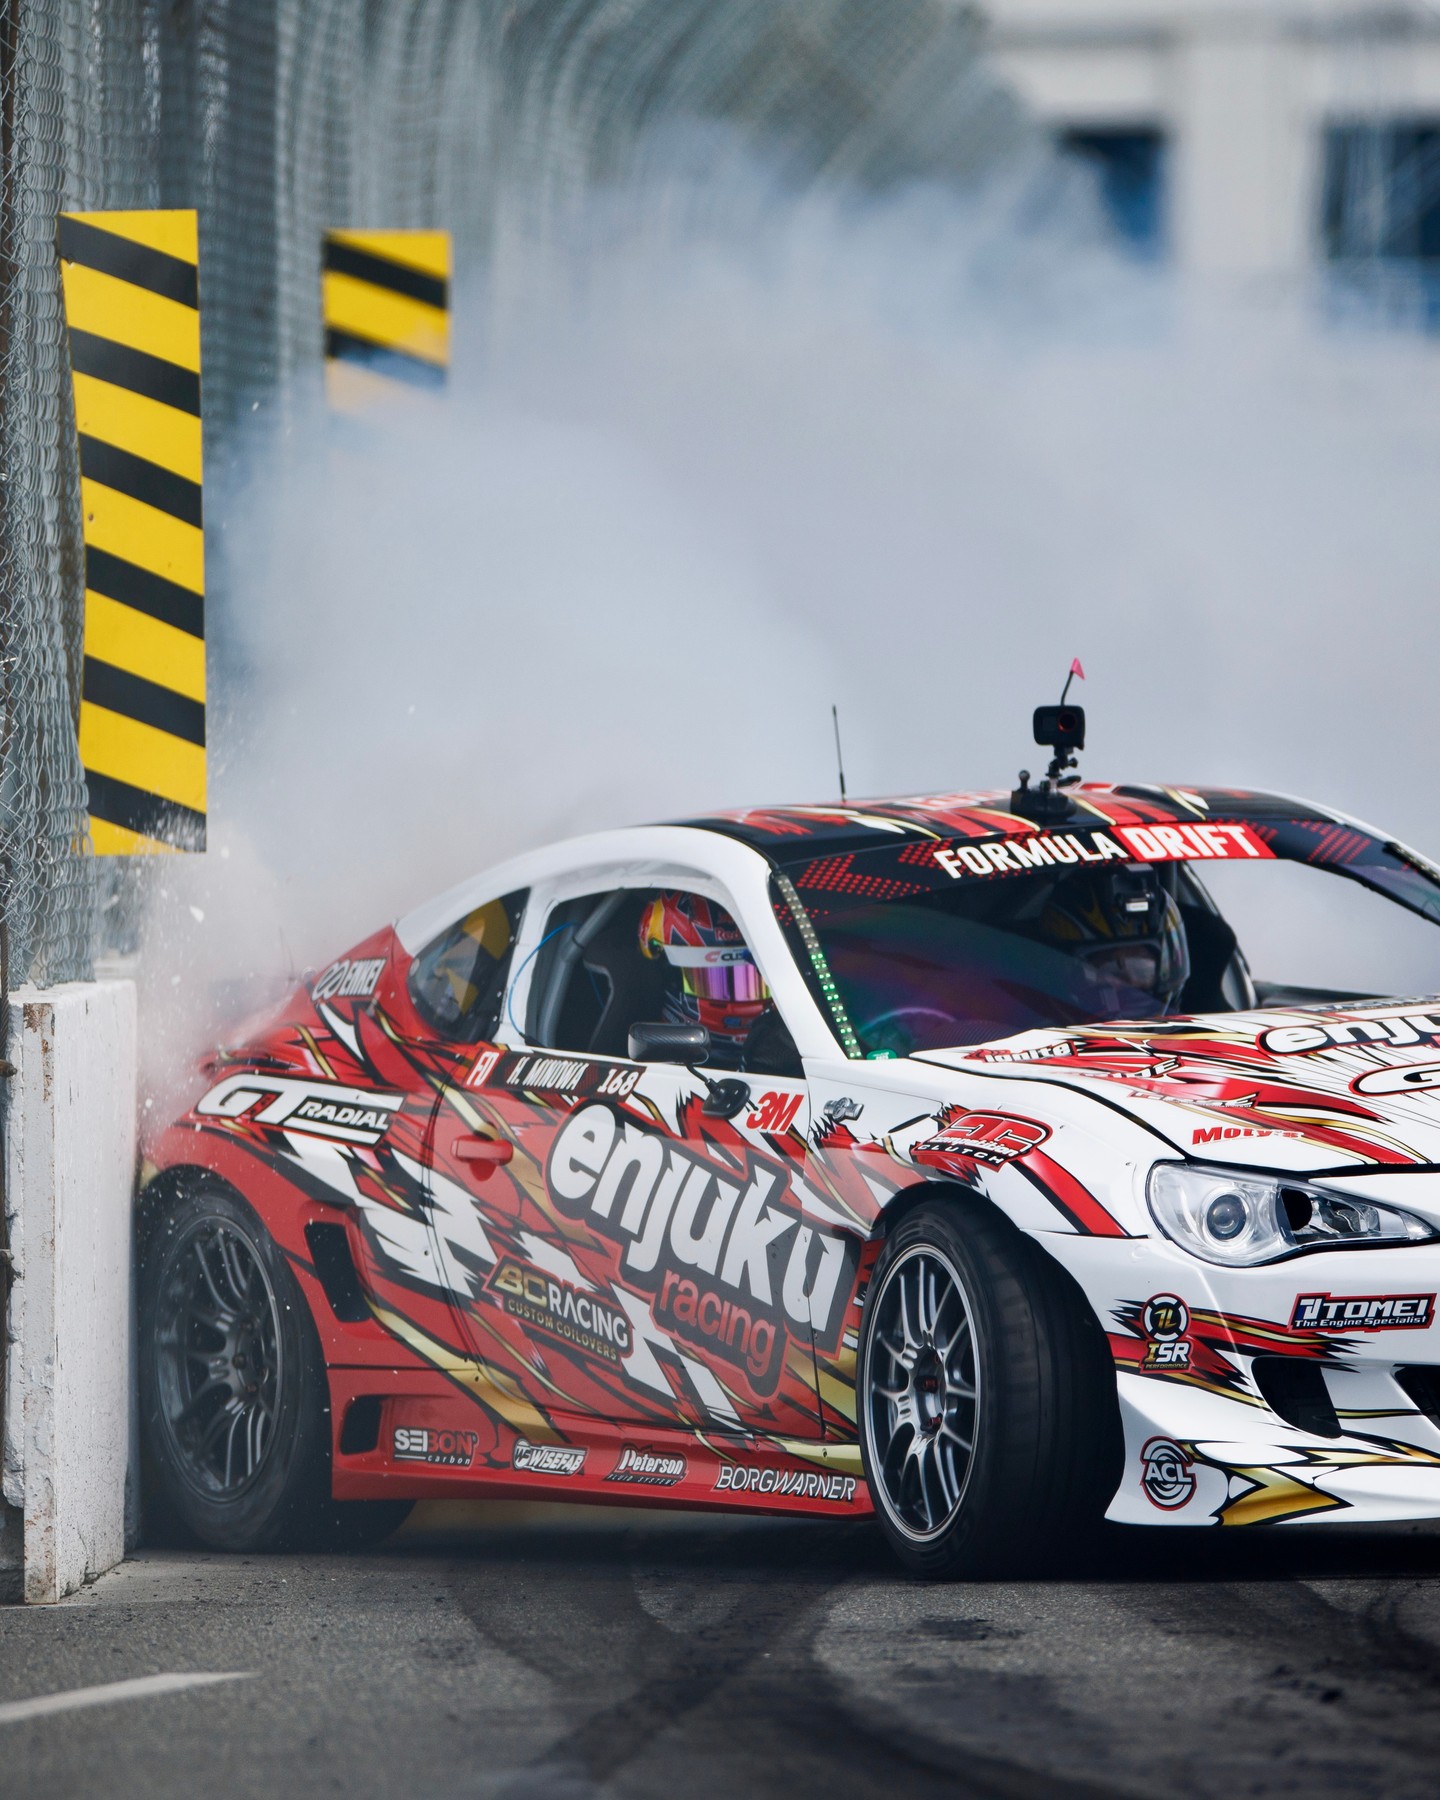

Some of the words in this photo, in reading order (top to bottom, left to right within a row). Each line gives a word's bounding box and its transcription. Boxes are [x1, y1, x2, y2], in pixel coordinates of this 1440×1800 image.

[933, 832, 1128, 879] FORMULA
[1120, 825, 1260, 860] DRIFT
[337, 958, 387, 997] ENKEI
[466, 1051, 500, 1087] FD
[506, 1056, 531, 1085] H.
[522, 1058, 590, 1091] MINOWA
[597, 1068, 640, 1097] 168
[197, 1073, 405, 1125] GT
[746, 1091, 805, 1134] 3M
[298, 1101, 390, 1130] RADIAL
[917, 1144, 1004, 1164] CLUTCH
[550, 1103, 847, 1333] enjuku
[508, 1299, 554, 1329] CUSTOM
[556, 1320, 617, 1362] COILOVERS
[548, 1282, 628, 1348] RACING
[659, 1269, 777, 1377] racing
[1295, 1319, 1318, 1328] The
[1320, 1318, 1361, 1328] Engine
[1364, 1315, 1427, 1327] Specialist
[1144, 1342, 1190, 1363] ISR
[394, 1428, 474, 1456] SEIBON
[427, 1454, 471, 1466] carbon
[529, 1449, 584, 1471] WISEFAB
[618, 1449, 685, 1475] Peterson
[1144, 1461, 1193, 1484] ACL
[607, 1473, 633, 1483] FLUID
[637, 1476, 677, 1486] SYSTEMS
[715, 1465, 857, 1500] BORGWARNER
